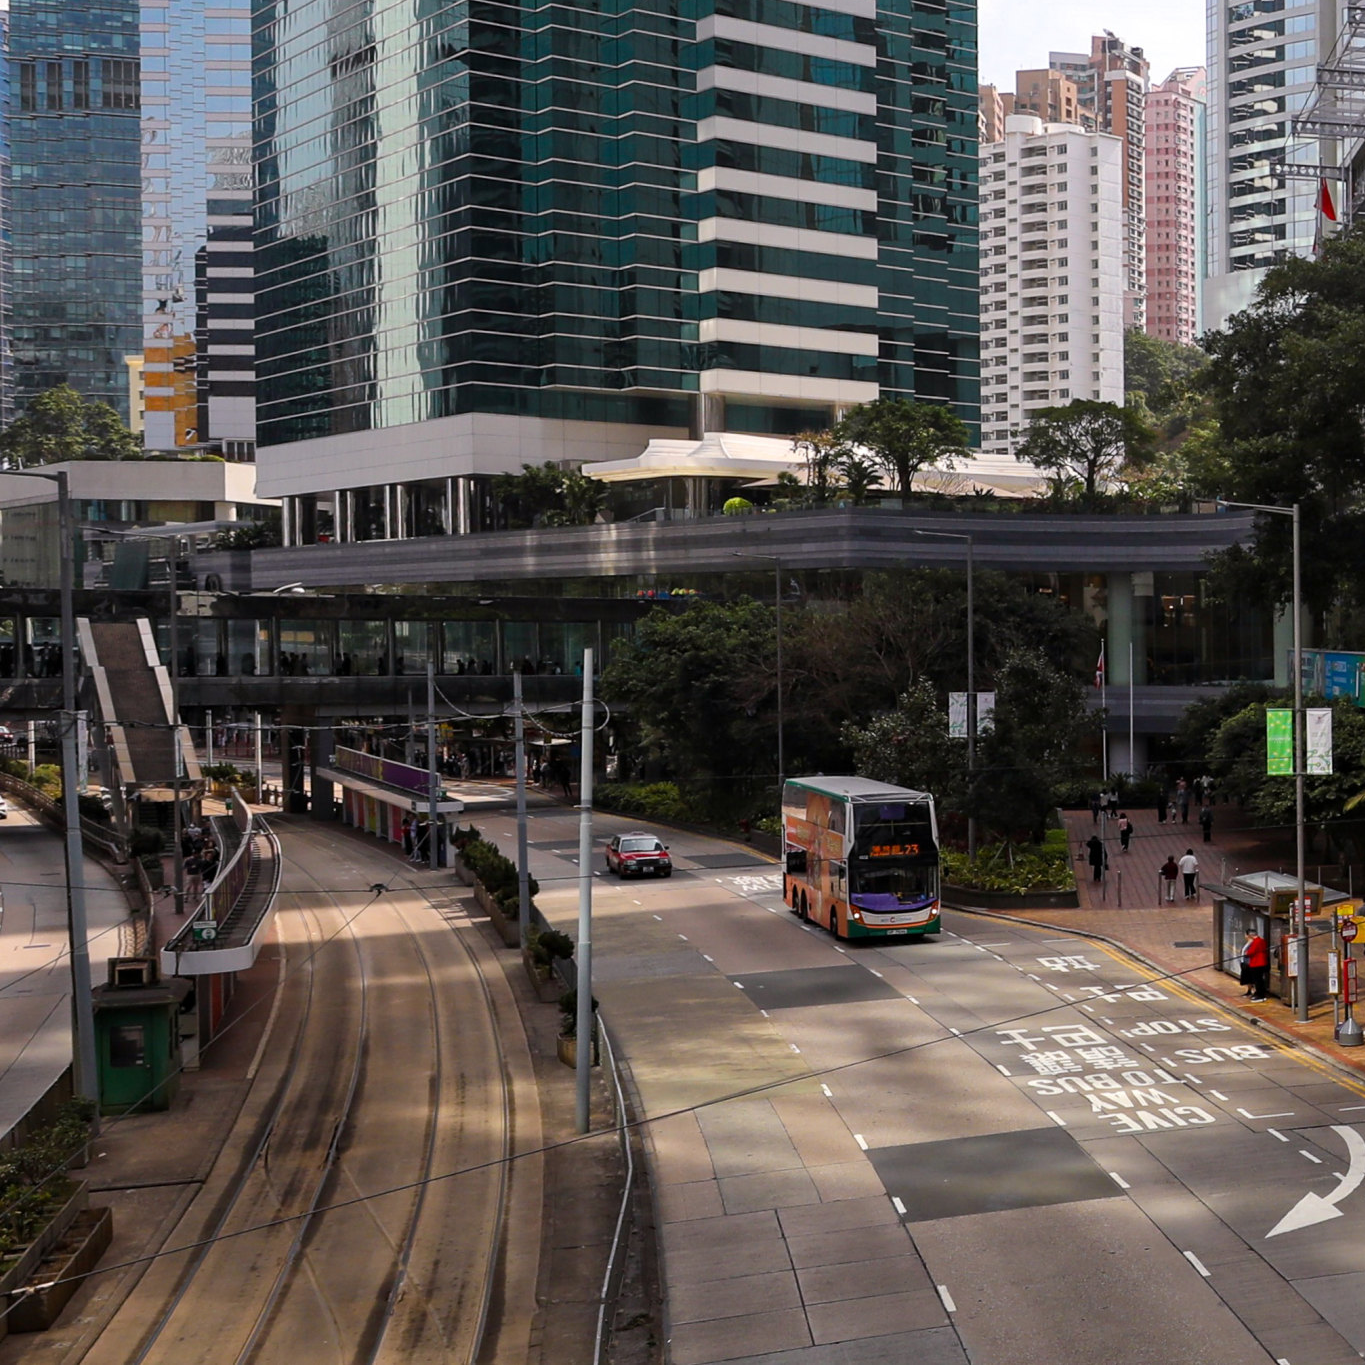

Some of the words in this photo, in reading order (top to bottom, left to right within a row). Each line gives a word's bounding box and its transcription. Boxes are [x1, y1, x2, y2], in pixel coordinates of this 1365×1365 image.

[1035, 955, 1101, 972] 站
[1080, 984, 1169, 1003] 巴士
[1130, 1018, 1232, 1035] STOP
[996, 1024, 1108, 1050] 巴士
[1175, 1045, 1271, 1064] BUS
[1027, 1072, 1122, 1095] BUS
[1121, 1068, 1186, 1088] TO
[1084, 1088, 1181, 1112] WAY
[1098, 1105, 1216, 1133] GIVE
